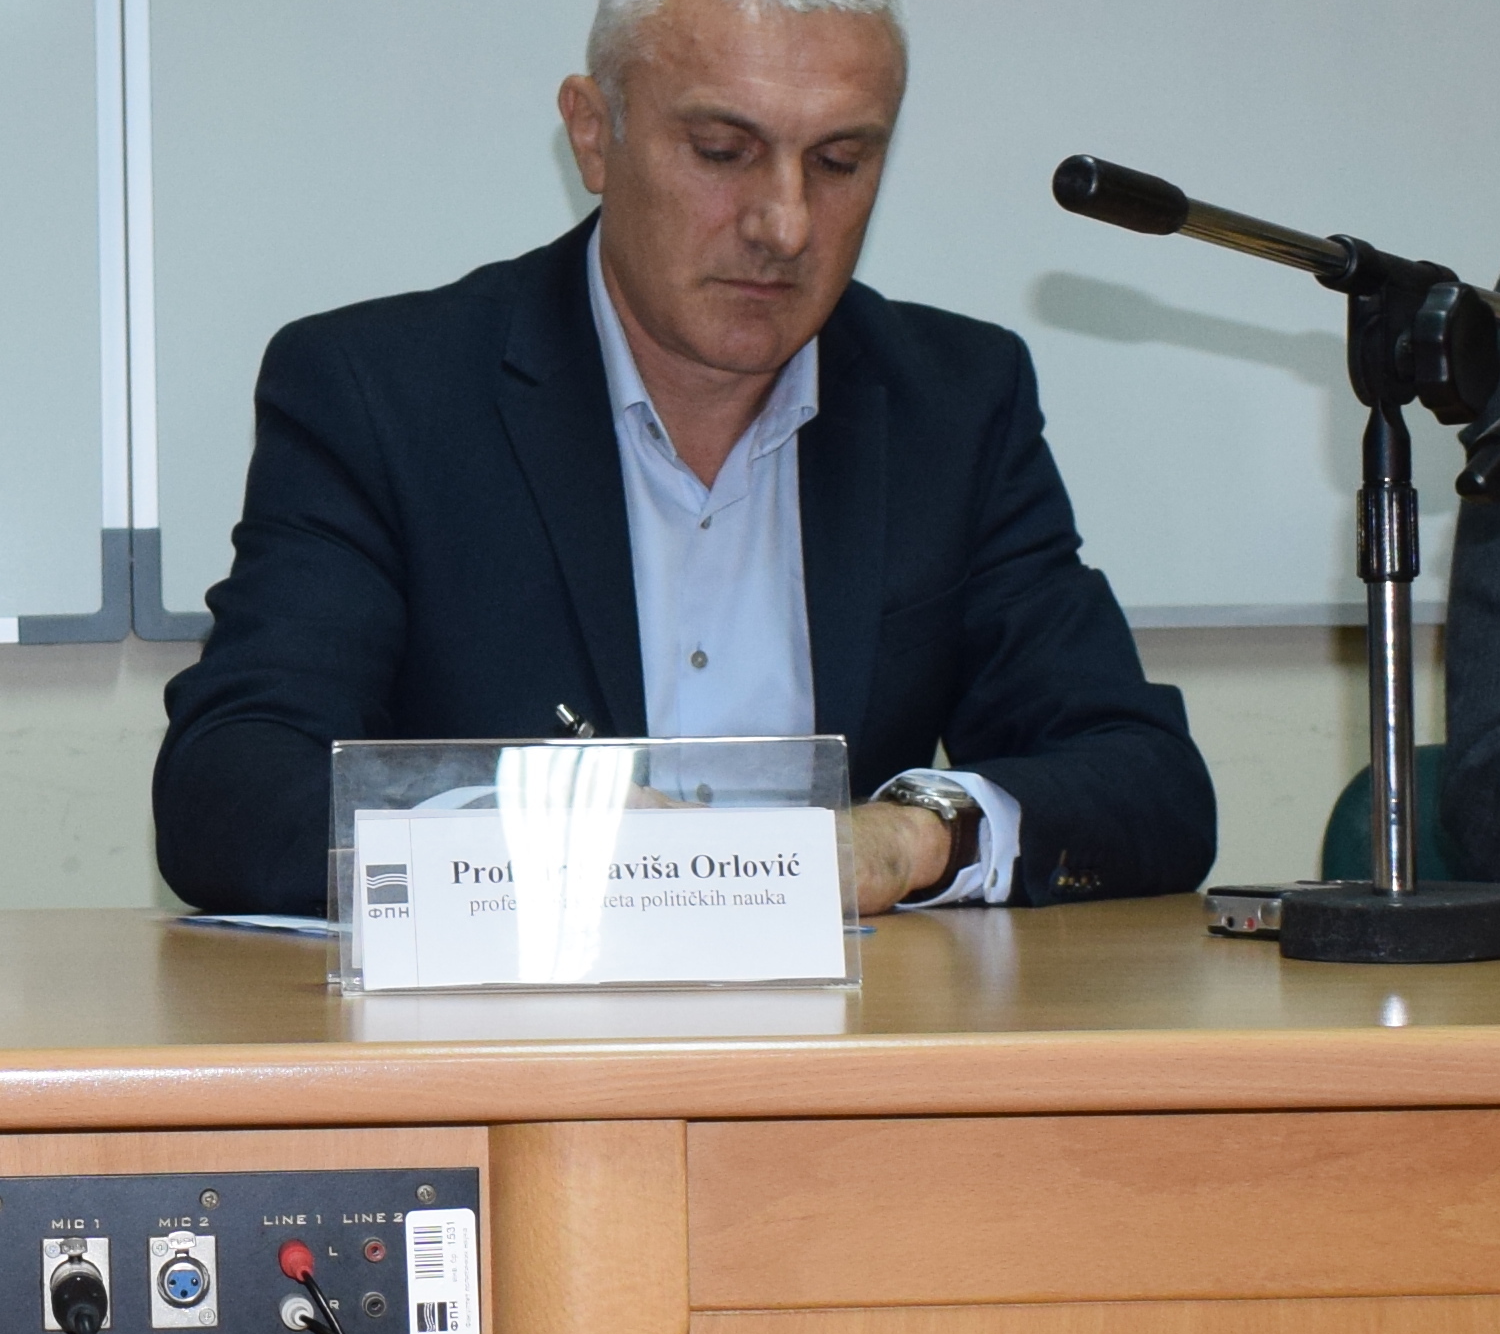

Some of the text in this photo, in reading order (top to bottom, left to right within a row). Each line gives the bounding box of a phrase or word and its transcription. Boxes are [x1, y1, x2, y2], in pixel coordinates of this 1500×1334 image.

[592, 855, 680, 880] aviša
[690, 852, 802, 880] Orlović
[640, 889, 727, 912] političkih
[732, 889, 786, 906] nauka
[368, 907, 410, 919] ФПН
[158, 1217, 210, 1227] MIC 2
[263, 1214, 322, 1225] LINE 1
[343, 1212, 404, 1223] LINE 2
[51, 1218, 100, 1229] MIC 1
[446, 1221, 456, 1245] 1531
[328, 1246, 338, 1256] L
[329, 1299, 339, 1310] R
